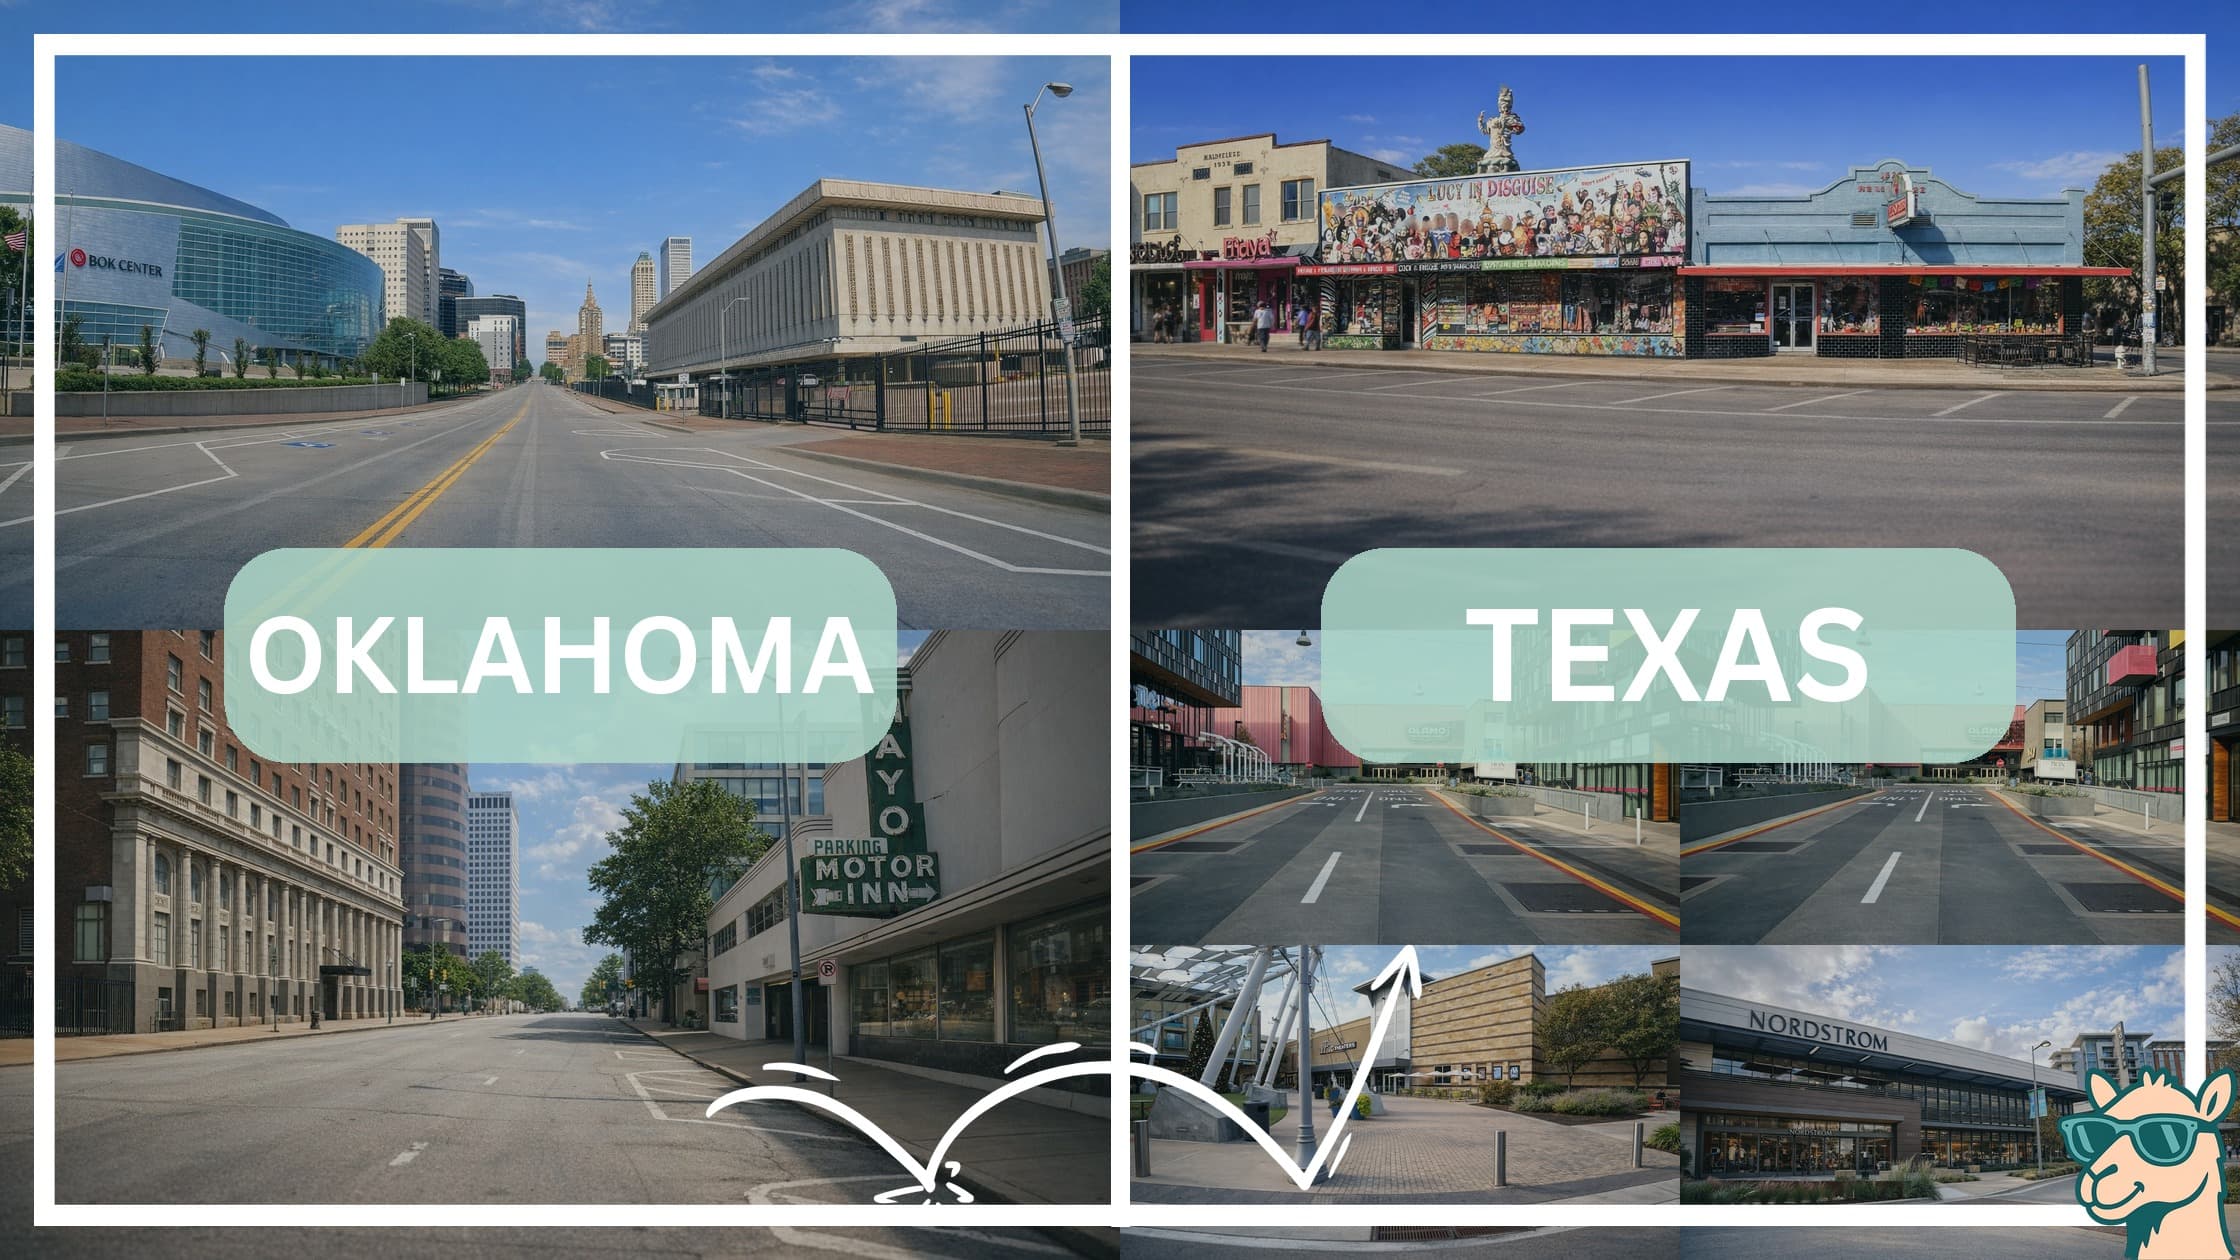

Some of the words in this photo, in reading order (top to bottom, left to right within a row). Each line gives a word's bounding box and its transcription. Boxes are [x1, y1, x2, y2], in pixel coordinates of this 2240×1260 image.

[1426, 184, 1464, 201] LUCY
[1469, 181, 1483, 199] IN
[1487, 176, 1555, 197] DISGUISE
[88, 254, 116, 270] BOK
[119, 259, 162, 277] CENTER
[814, 839, 881, 854] PARKING
[815, 854, 935, 880] MOTOR
[847, 881, 909, 904] INN
[1750, 1009, 1888, 1051] NORDSTROM
[1789, 1128, 1833, 1136] NORDSTROM
